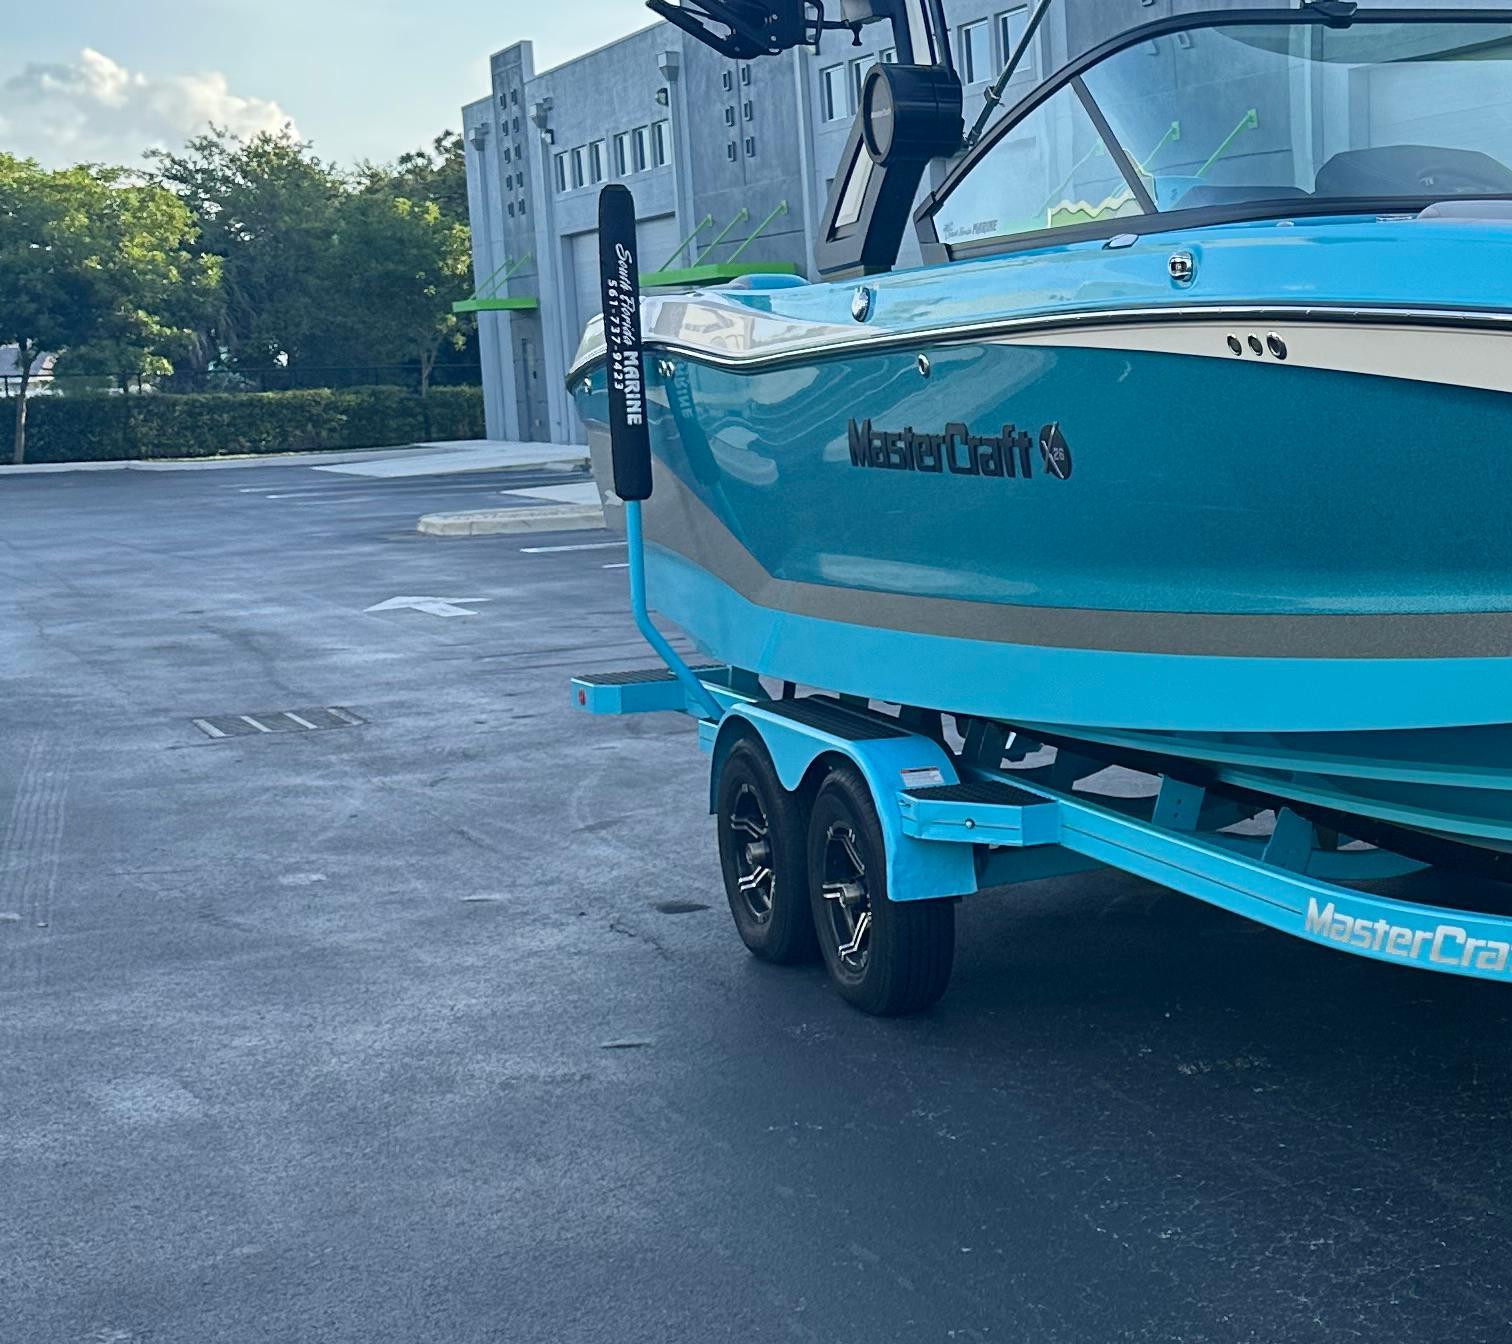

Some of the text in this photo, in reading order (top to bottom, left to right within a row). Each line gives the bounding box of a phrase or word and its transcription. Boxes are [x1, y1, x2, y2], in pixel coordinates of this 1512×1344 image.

[607, 279, 624, 390] 561-737-9423
[615, 242, 642, 426] South Florida MARINE
[848, 417, 1033, 479] MasterCraft
